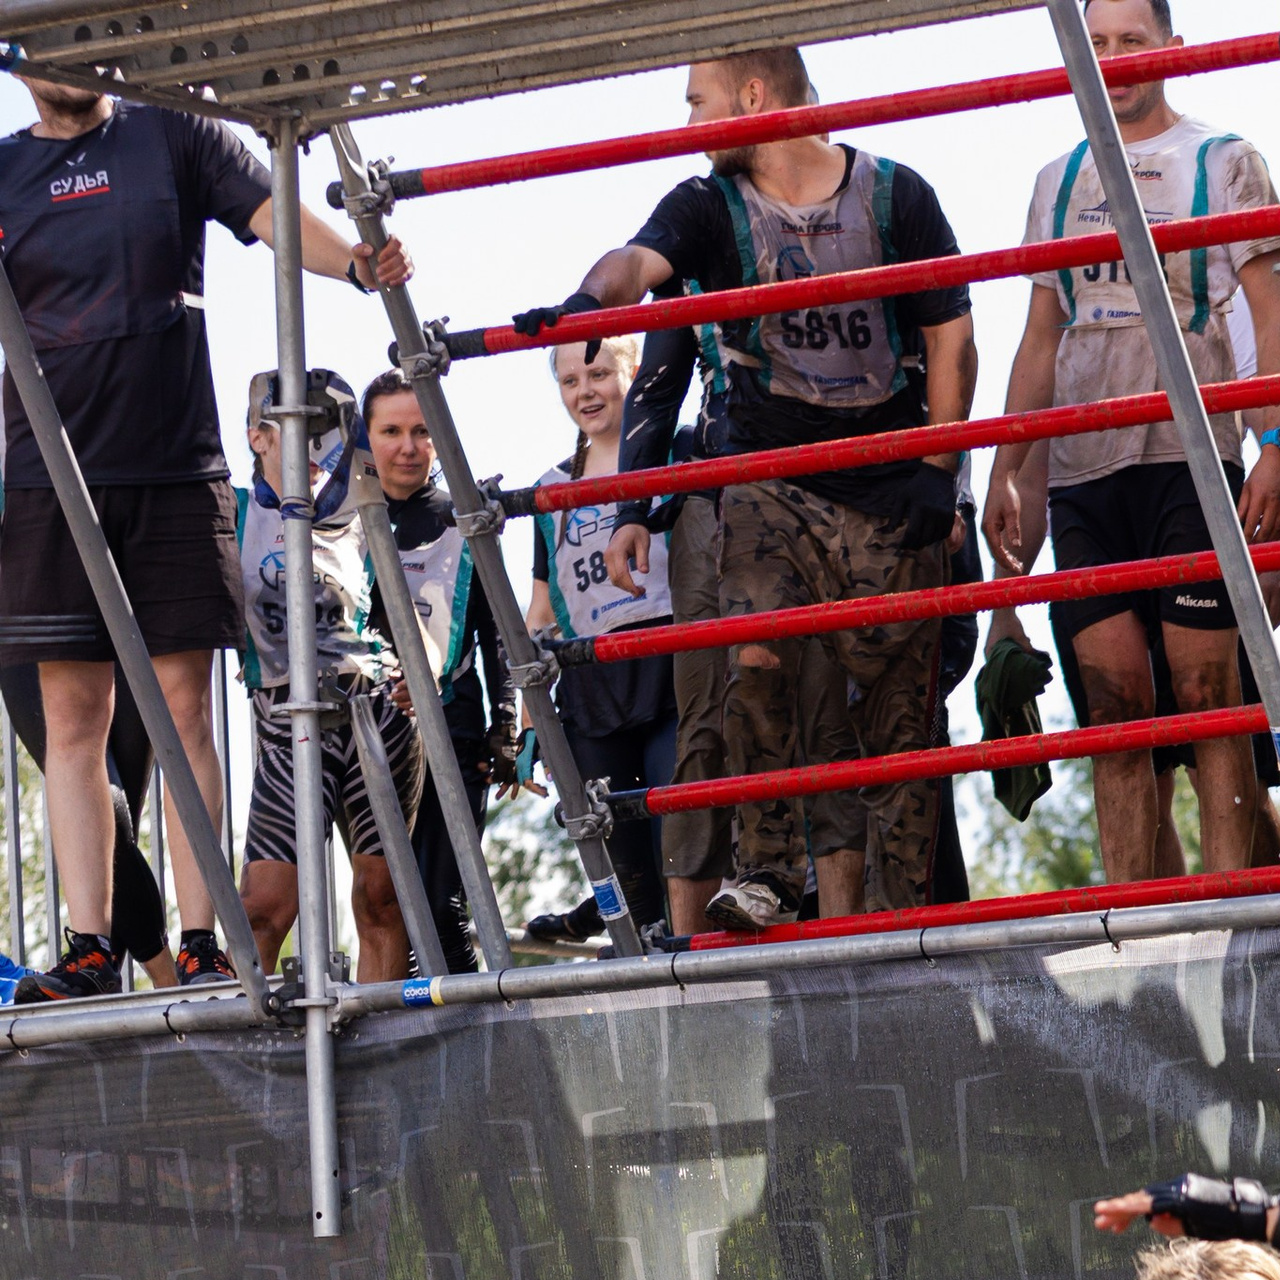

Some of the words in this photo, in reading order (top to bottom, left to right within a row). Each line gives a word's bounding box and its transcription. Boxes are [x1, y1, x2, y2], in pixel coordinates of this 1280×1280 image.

[50, 170, 109, 196] СУДЬЯ
[1077, 212, 1101, 223] Нева
[780, 308, 873, 350] 5816
